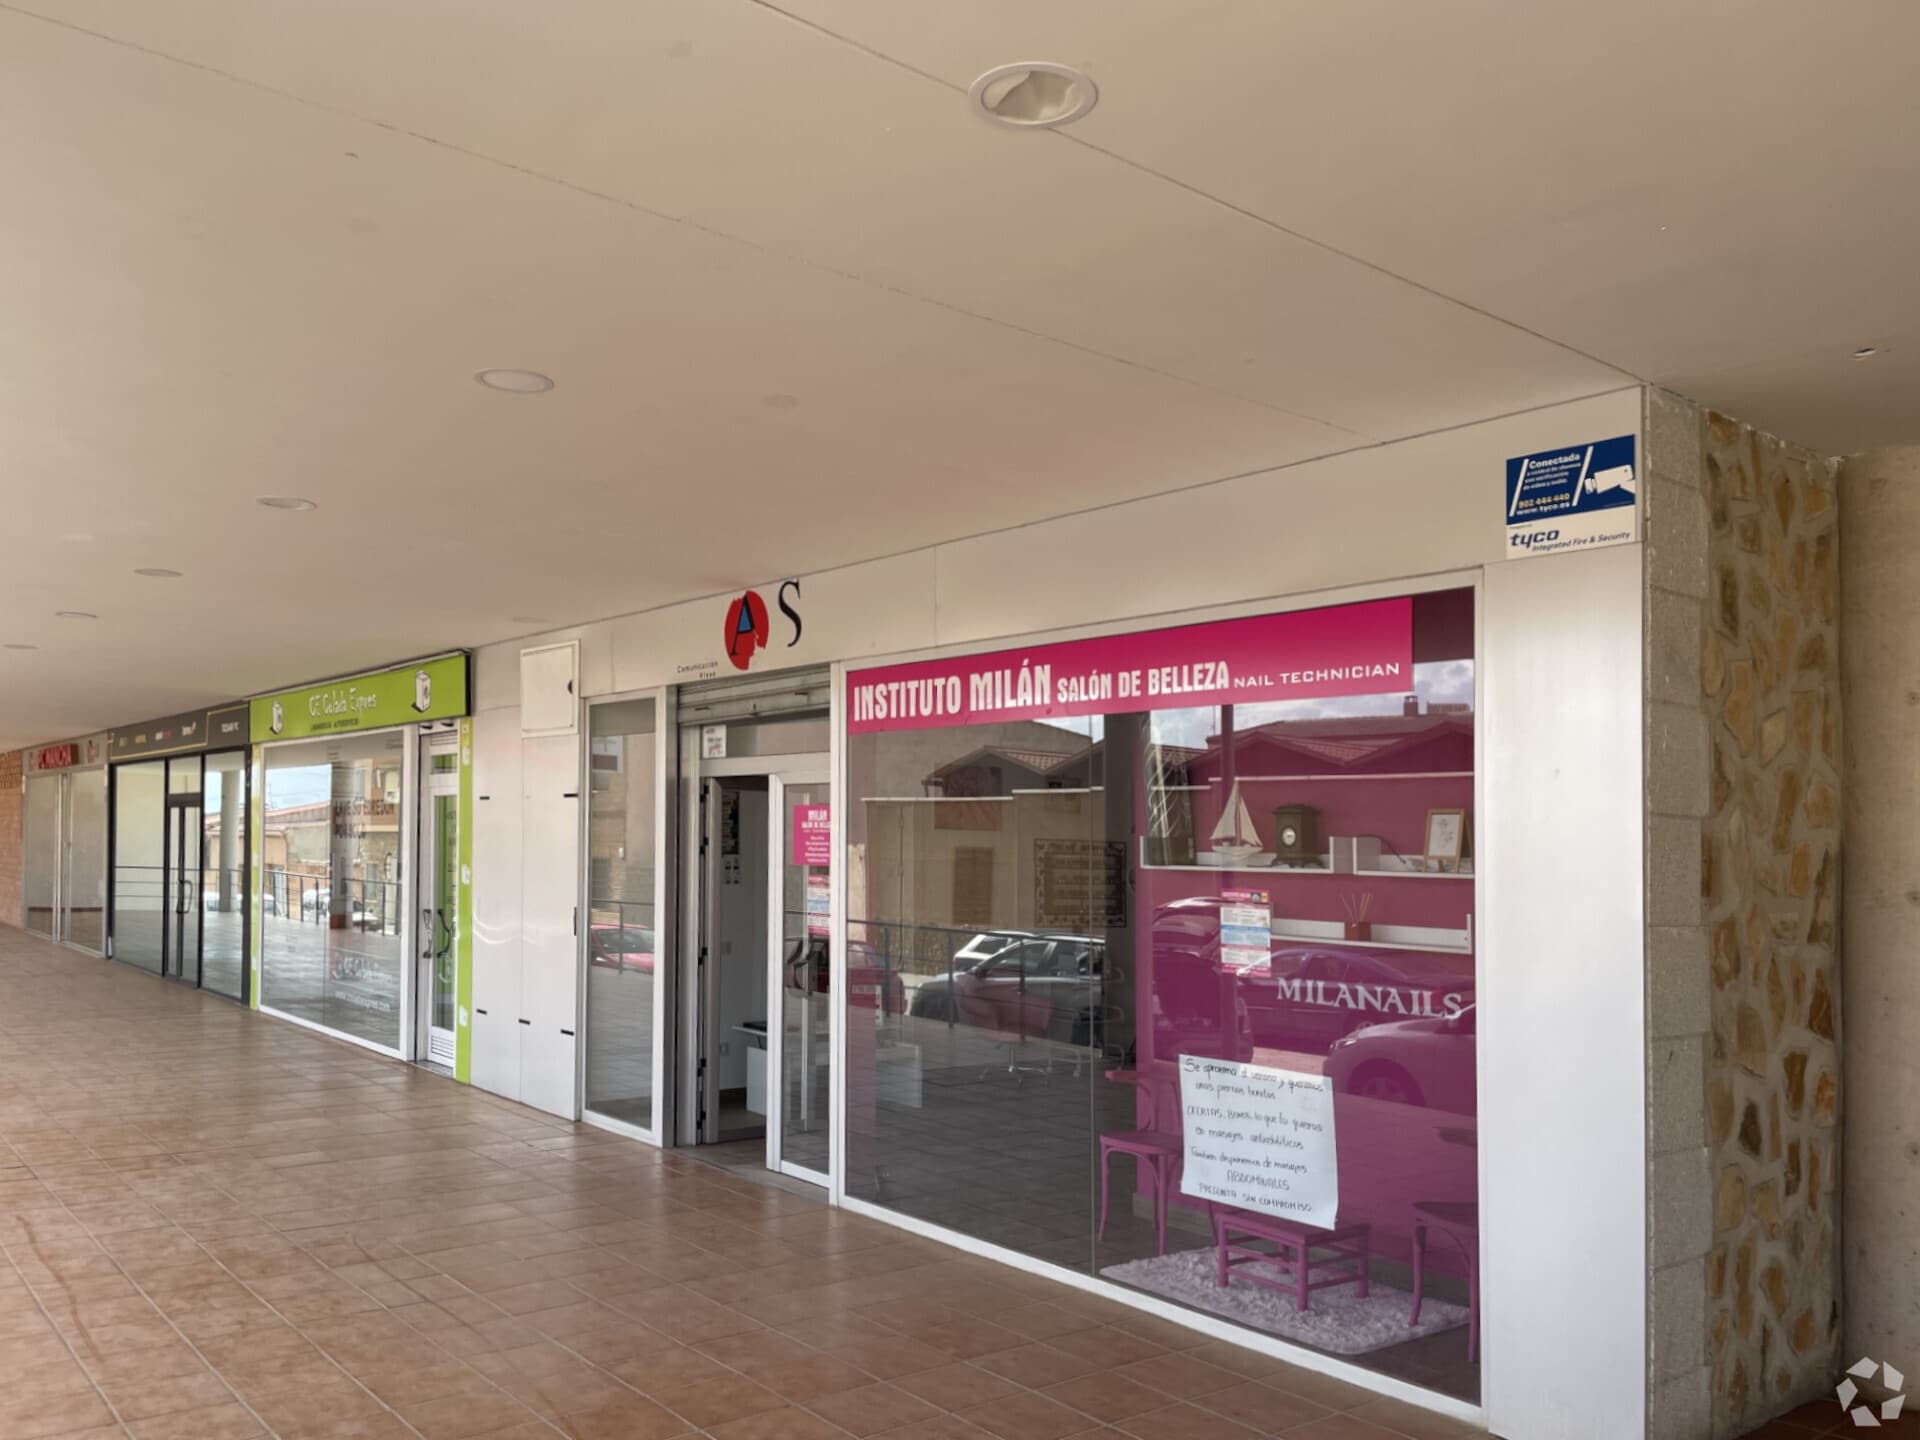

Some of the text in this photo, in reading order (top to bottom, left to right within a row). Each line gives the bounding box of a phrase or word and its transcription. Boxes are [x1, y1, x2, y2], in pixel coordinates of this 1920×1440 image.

[1529, 453, 1581, 469] Conectada
[1510, 529, 1559, 548] tyco
[1532, 531, 1632, 552] Integrated Fire & Security
[853, 658, 1401, 722] INSTITUTO MILÁN SALÓN DE BELLEZA NAIL TECHNICIAN
[1277, 977, 1463, 1020] MILANAILS
[1185, 1058, 1200, 1073] Se
[1263, 1155, 1273, 1168] de
[1226, 1169, 1291, 1191] ABDOMINALES
[1198, 1183, 1237, 1198] PREGUNTA
[1259, 1197, 1312, 1213] COMPROMISO
